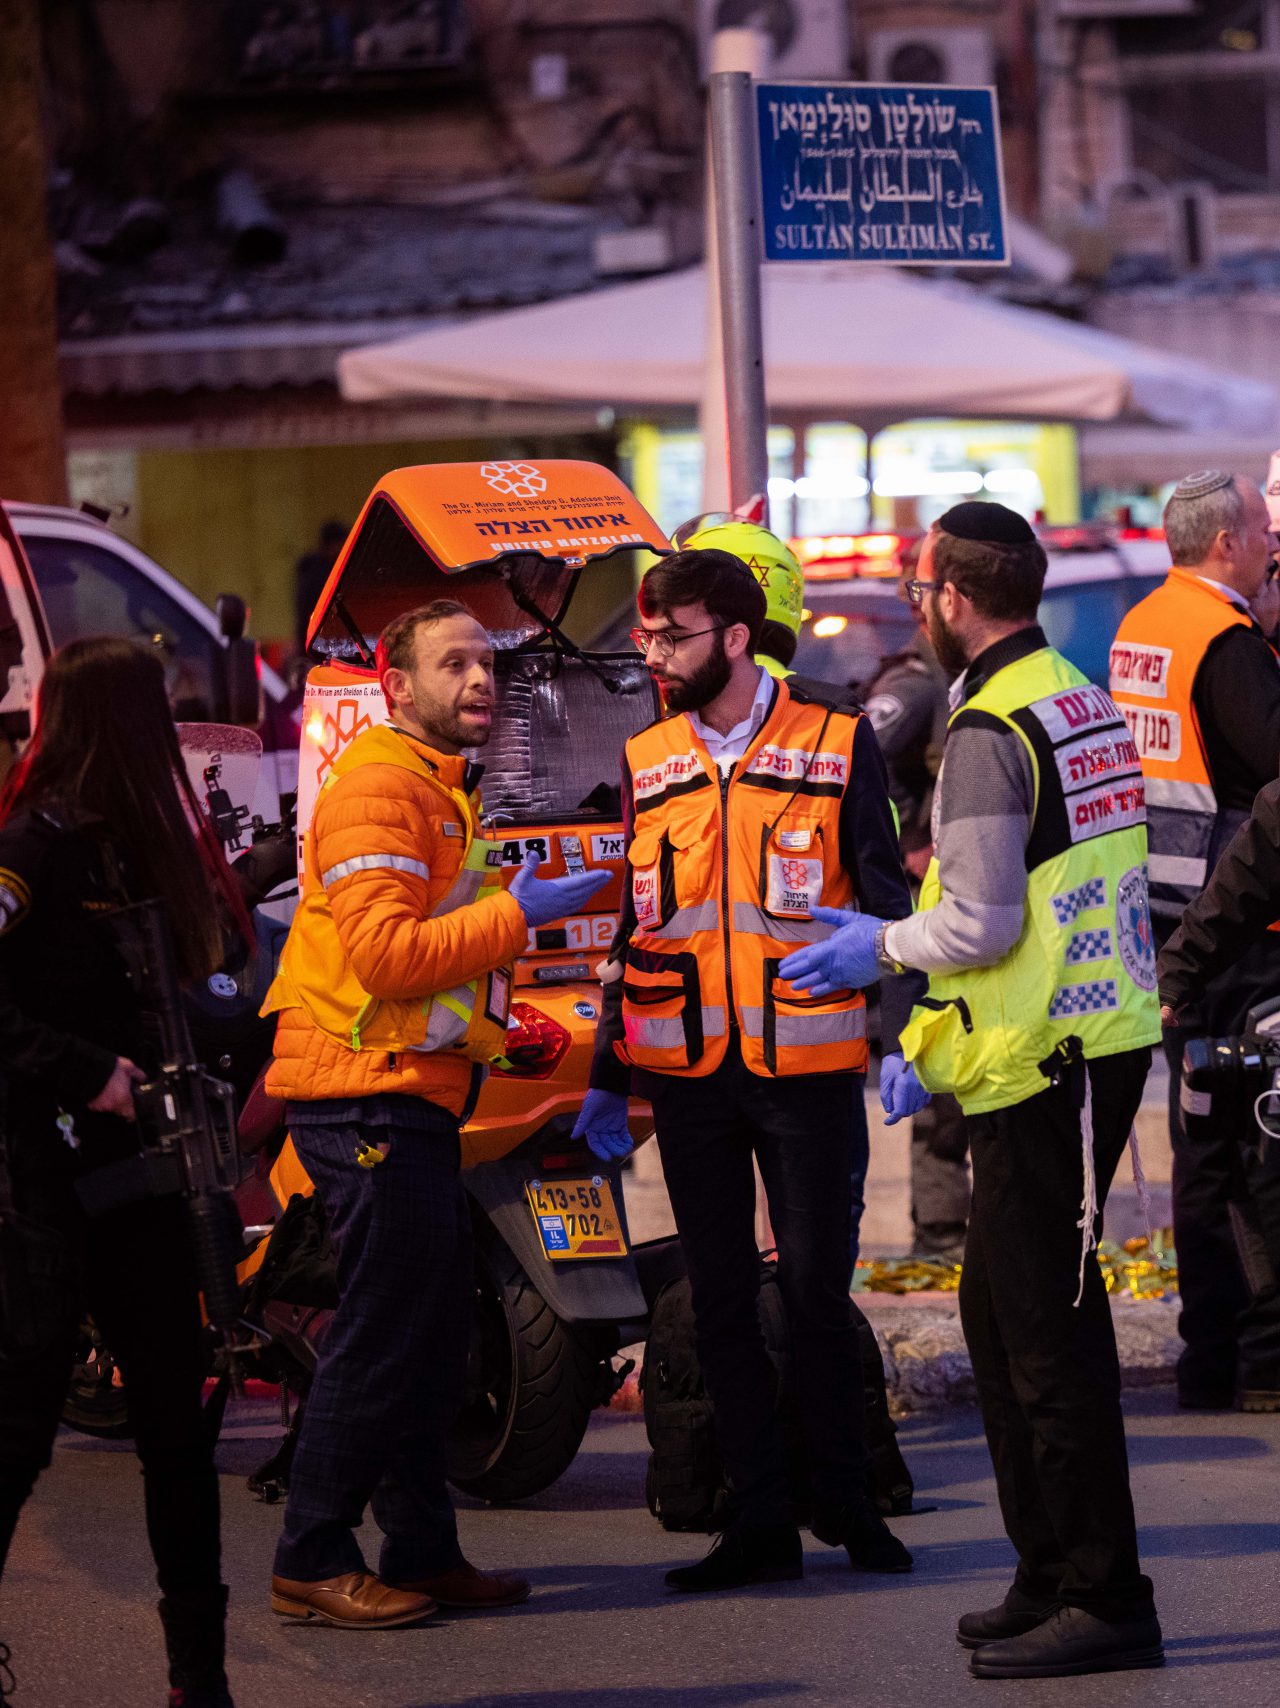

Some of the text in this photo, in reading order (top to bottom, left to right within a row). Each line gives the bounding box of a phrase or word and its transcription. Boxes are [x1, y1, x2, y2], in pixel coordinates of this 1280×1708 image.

[775, 224, 854, 250] SULTAN
[859, 224, 962, 250] SULEIMAN
[460, 502, 474, 510] Dr.
[475, 500, 505, 508] Miriam
[506, 499, 522, 507] and
[523, 498, 557, 506] Sheldon
[474, 513, 631, 537] איחוד הצלה
[490, 533, 644, 551] UNITED HATZALAH
[318, 688, 332, 696] Miriam
[333, 688, 342, 696] and
[343, 688, 362, 696] Sheldon
[1143, 713, 1170, 755] מגן
[783, 890, 808, 899] איחוד
[783, 899, 808, 908] הצלה
[576, 1005, 595, 1014] SYM
[566, 1213, 603, 1237] 702
[550, 1231, 560, 1239] IL
